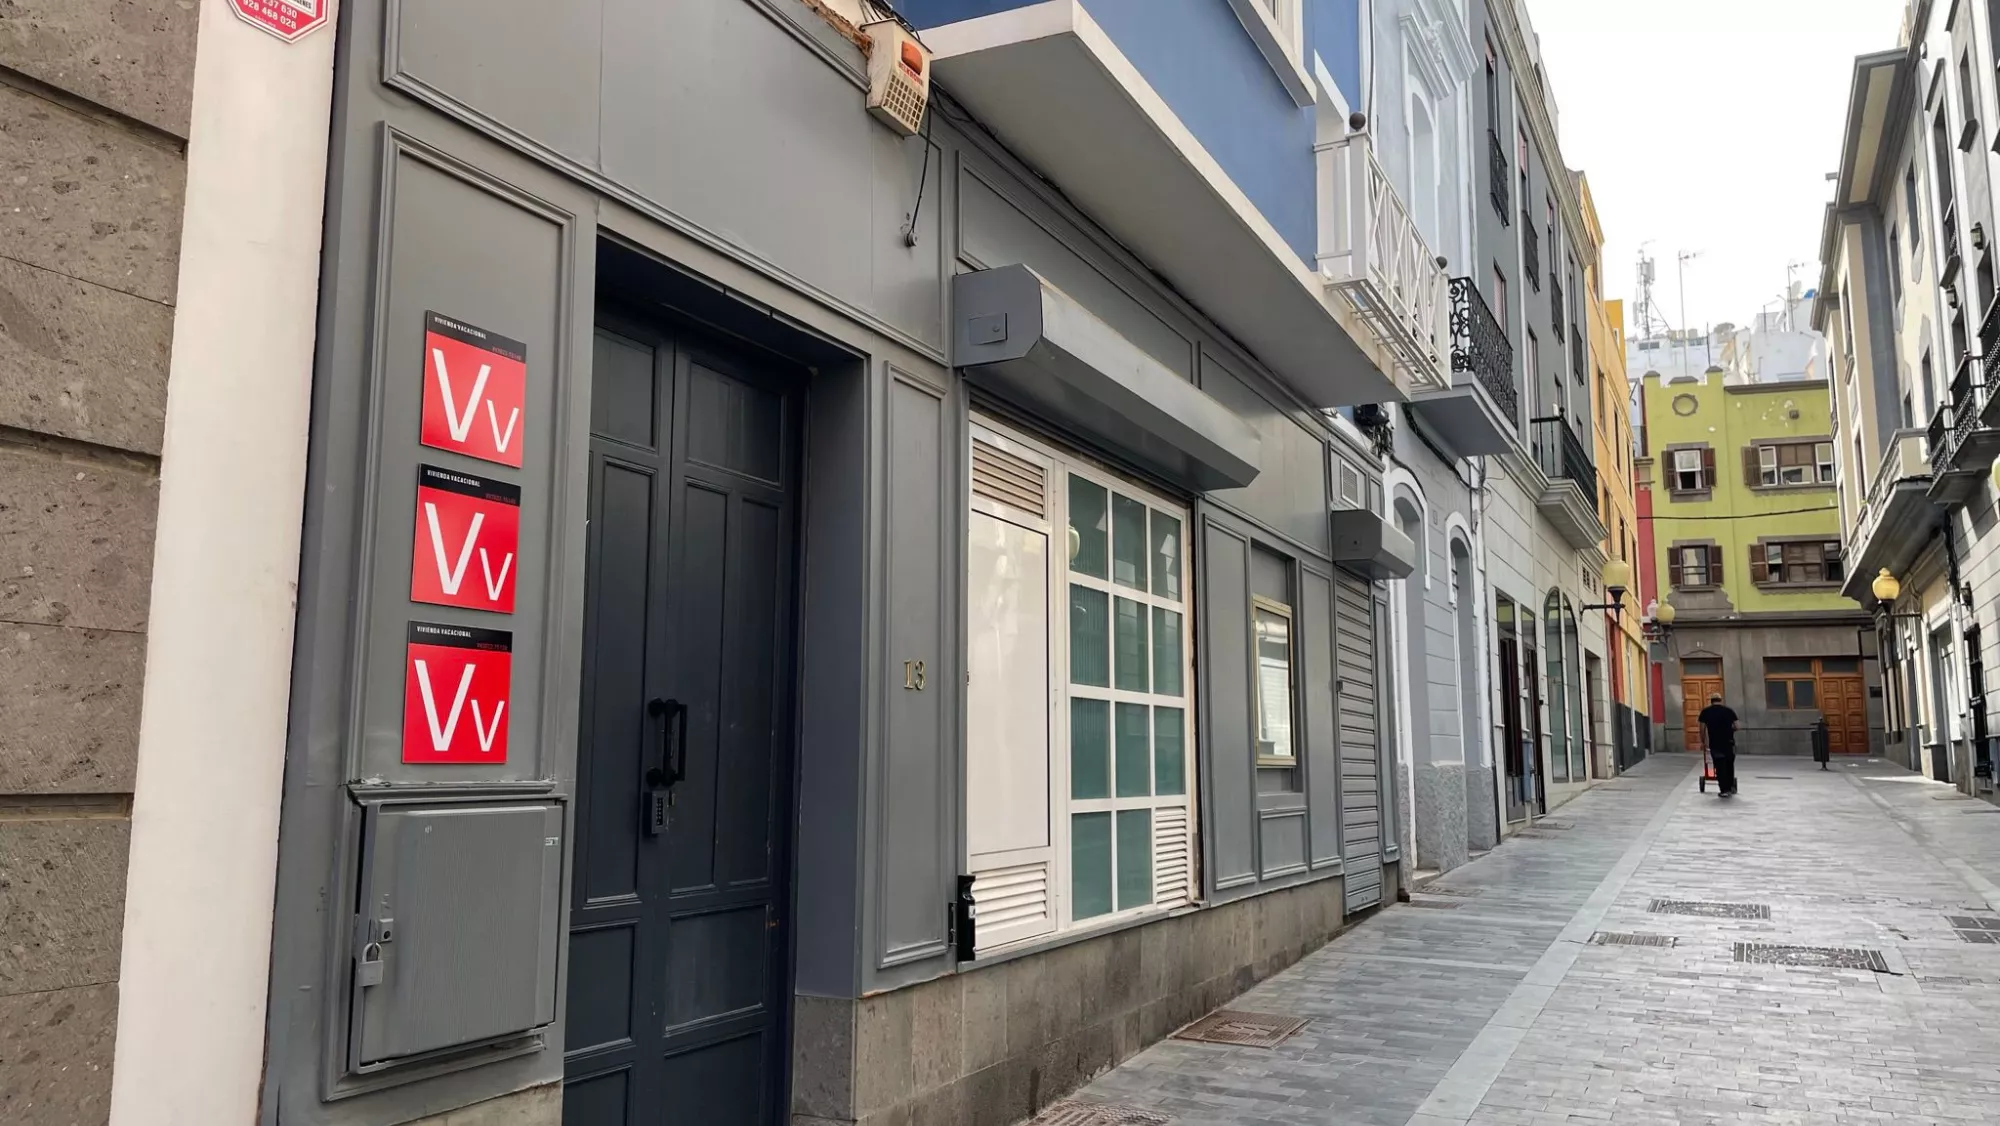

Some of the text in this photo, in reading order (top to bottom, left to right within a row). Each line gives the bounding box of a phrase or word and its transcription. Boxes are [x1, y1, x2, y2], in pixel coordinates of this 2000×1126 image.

[281, 4, 297, 19] 630
[281, 16, 296, 29] 028
[434, 316, 487, 340] VIVIENDA VACACIONAL
[427, 469, 481, 488] VIVIENDA VACACIONAL
[416, 625, 471, 638] VIVIENDA VACACIONAL
[903, 659, 927, 691] 13
